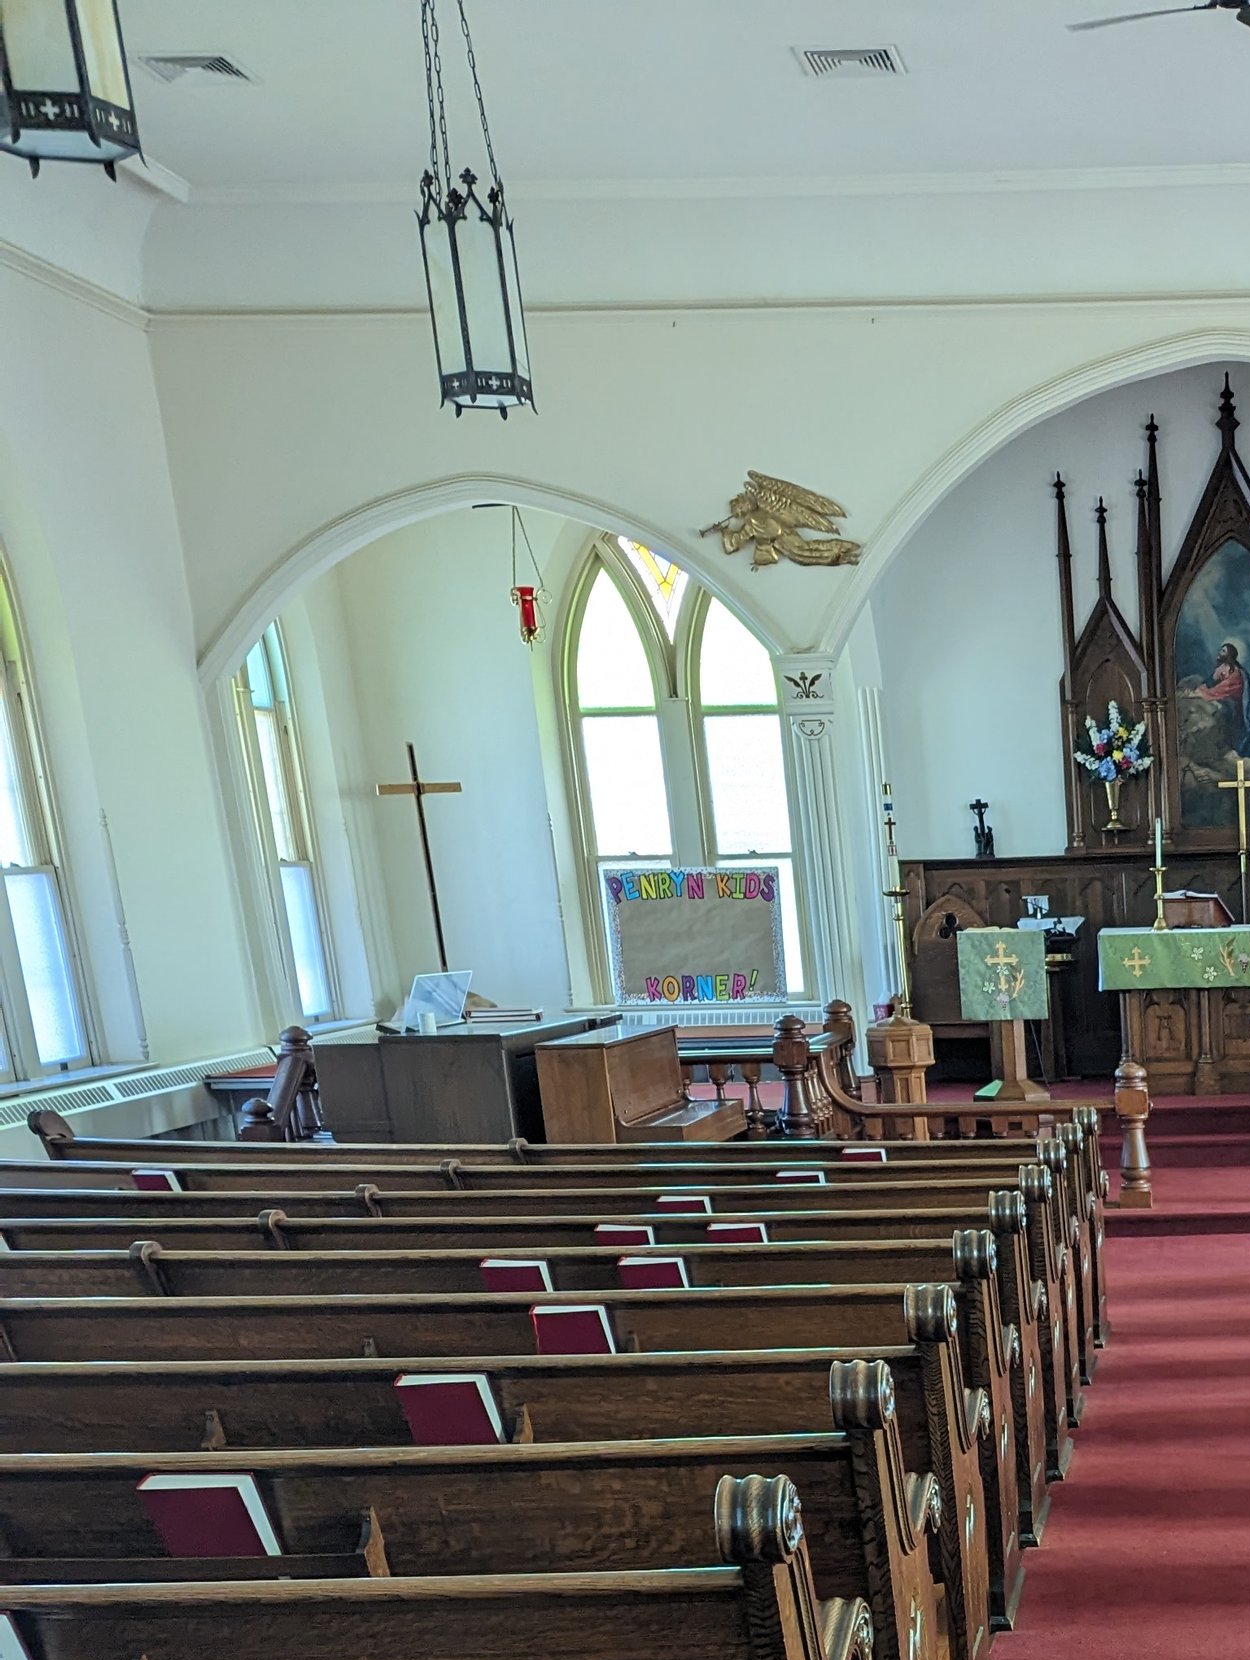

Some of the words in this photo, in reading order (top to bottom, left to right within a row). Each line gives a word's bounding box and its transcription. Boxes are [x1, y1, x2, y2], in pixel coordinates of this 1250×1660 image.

[606, 870, 705, 905] PENRYN
[715, 872, 776, 902] KIDS
[645, 969, 759, 1003] KORNER!
